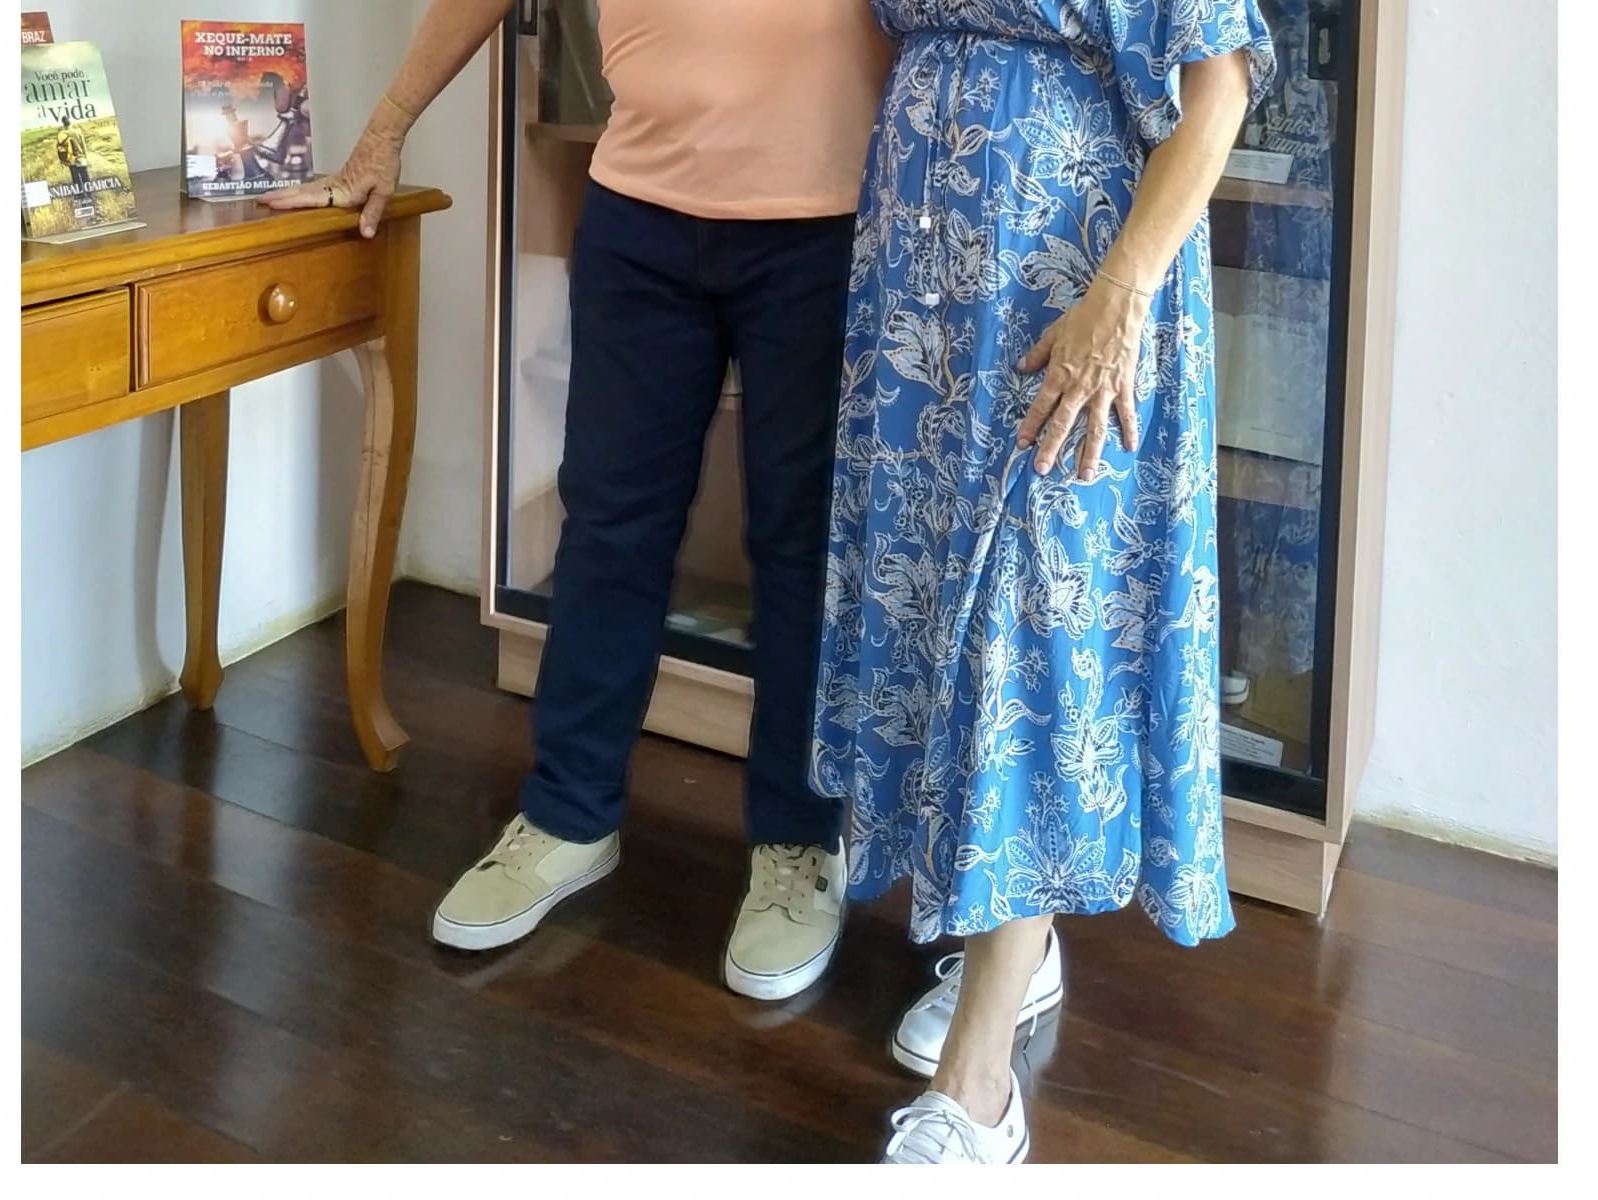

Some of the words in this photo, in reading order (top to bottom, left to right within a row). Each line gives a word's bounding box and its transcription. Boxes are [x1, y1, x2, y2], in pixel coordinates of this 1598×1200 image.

[22, 30, 47, 44] BRAZ
[194, 31, 292, 46] XEQUE-MATE
[203, 45, 224, 57] NO
[226, 45, 286, 57] INFERNO
[34, 70, 59, 82] Você
[61, 67, 85, 83] pode
[24, 79, 91, 104] amar
[48, 98, 97, 124] vida
[84, 177, 121, 193] GARCIA
[202, 180, 252, 191] SEBASTIÃO
